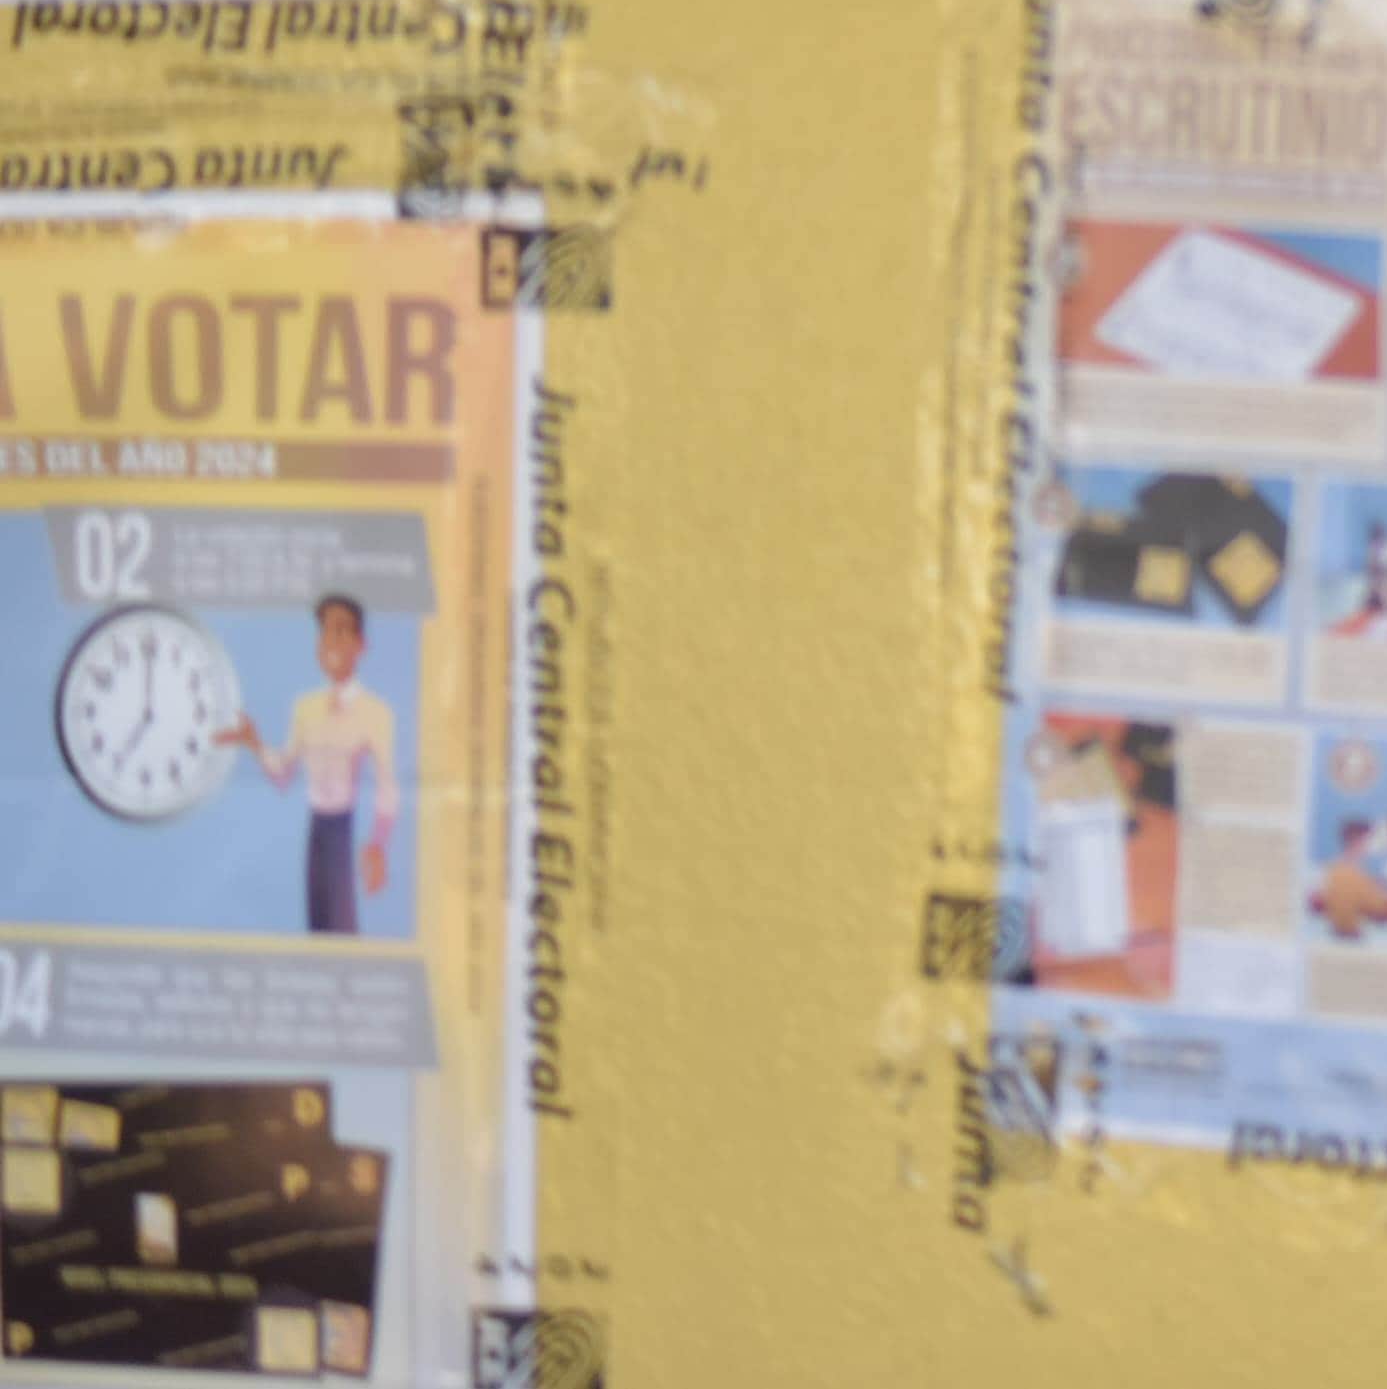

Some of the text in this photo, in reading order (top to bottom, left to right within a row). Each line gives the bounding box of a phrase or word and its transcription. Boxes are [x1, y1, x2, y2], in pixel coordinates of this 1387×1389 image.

[194, 142, 348, 189] Junta
[58, 292, 458, 424] VOTAR
[73, 509, 154, 601] 02
[526, 378, 575, 1120] Junta Central Electoral
